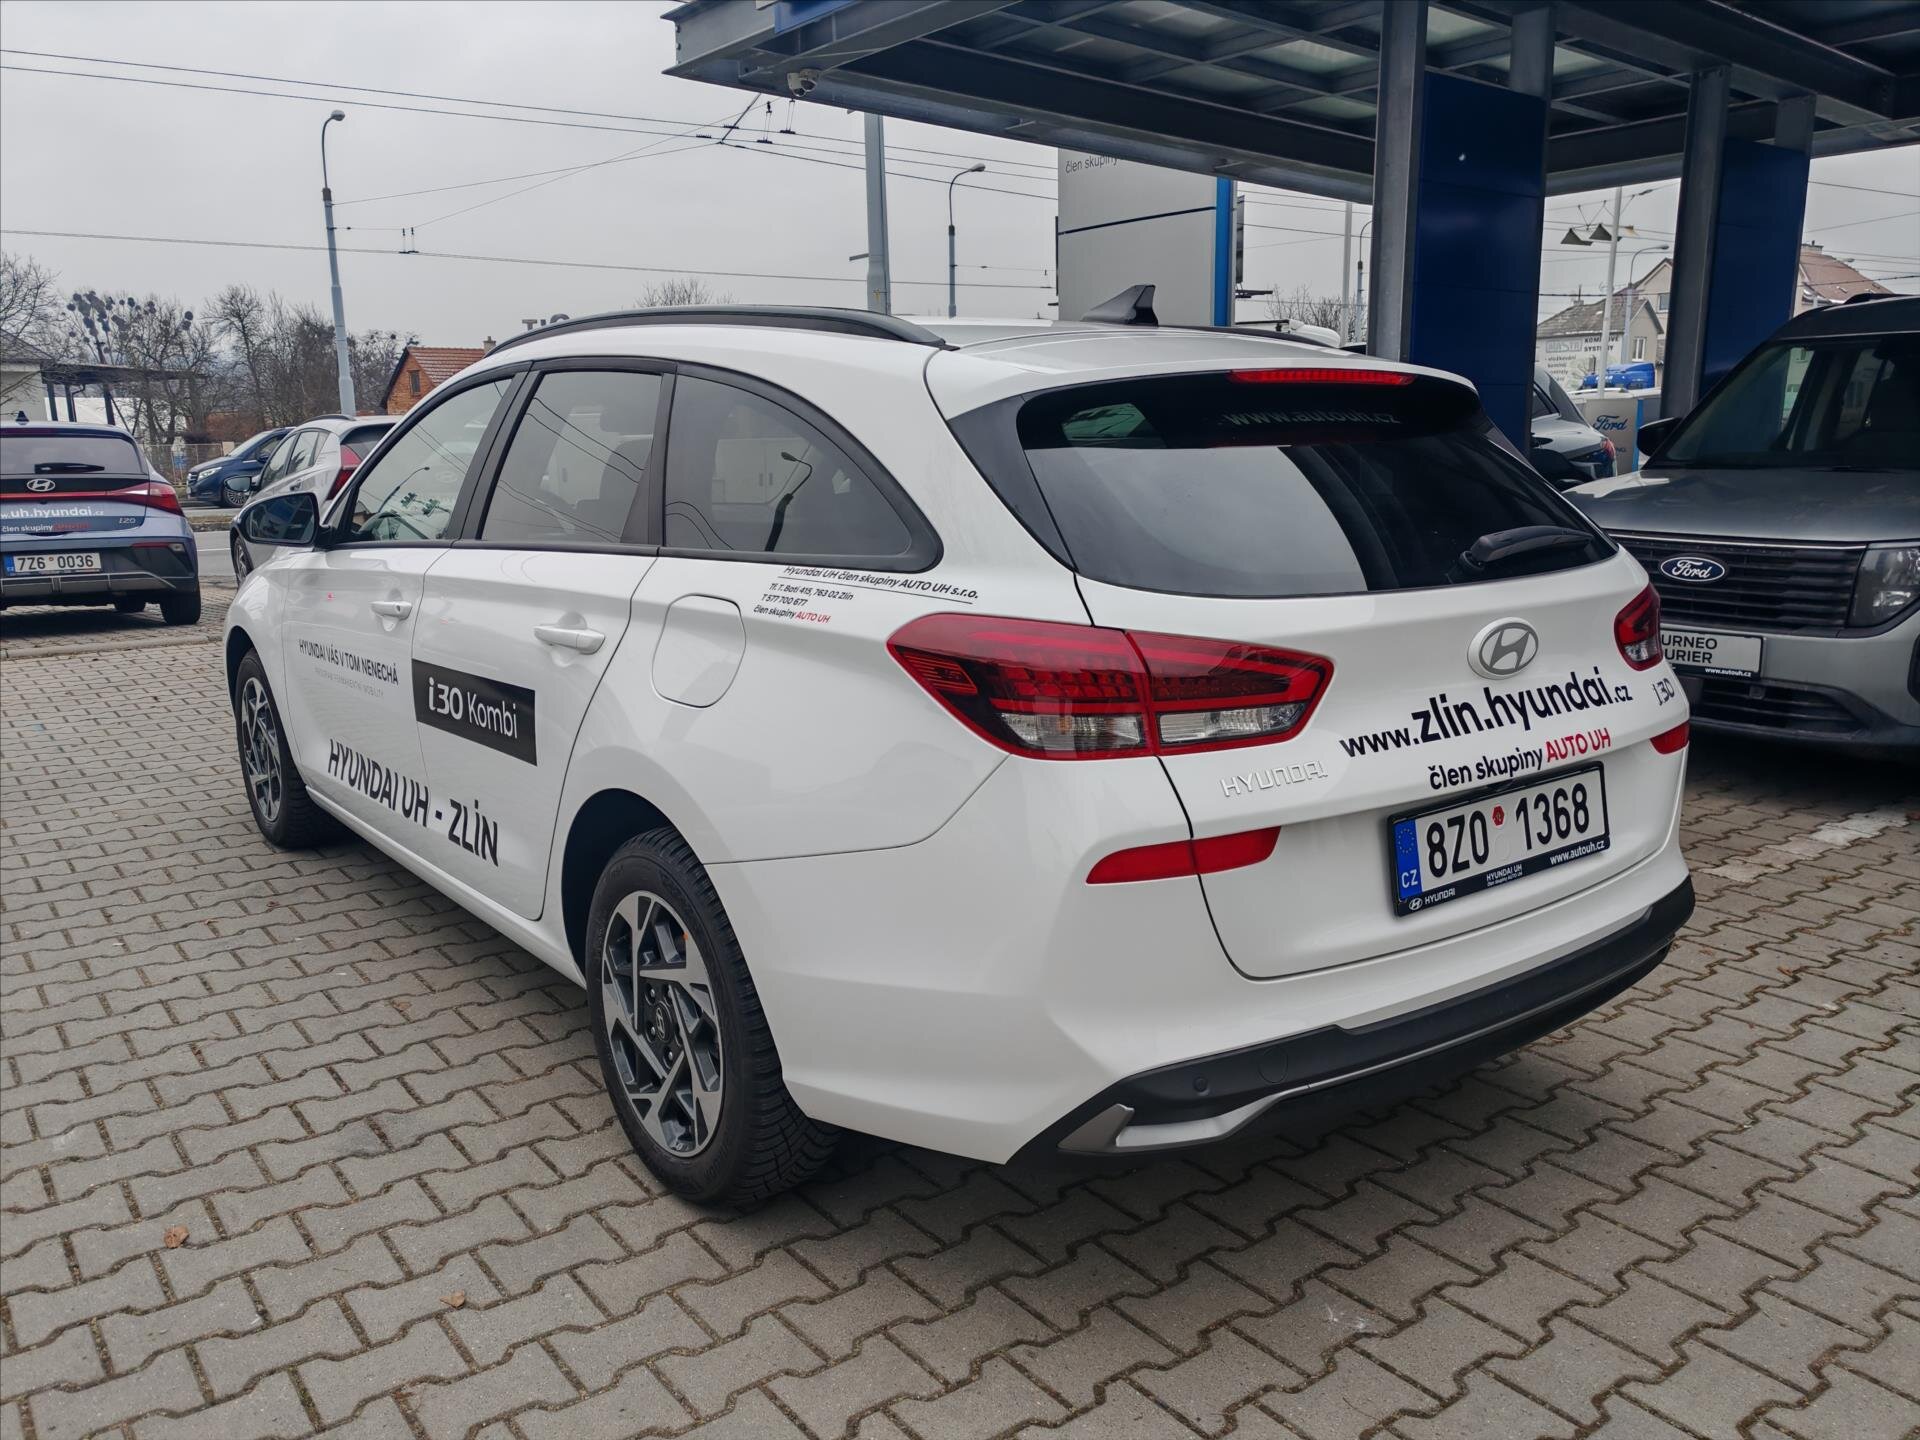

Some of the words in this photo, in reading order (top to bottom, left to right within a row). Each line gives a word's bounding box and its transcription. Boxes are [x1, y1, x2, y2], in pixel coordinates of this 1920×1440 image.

[1065, 160, 1083, 174] člen
[1085, 154, 1118, 169] skupiny
[1593, 414, 1629, 431] Ford
[0, 506, 104, 518] w.uh.hyundai.cz
[2, 524, 20, 532] člen
[21, 523, 53, 532] skupiny
[17, 556, 46, 571] 7Z6
[57, 554, 94, 568] 0036
[1672, 560, 1710, 578] Ford
[784, 566, 823, 575] Hyundai
[823, 569, 838, 578] UH
[838, 571, 859, 581] člen
[859, 574, 900, 586] skupiny
[899, 579, 932, 591] AUTO
[933, 583, 951, 594] UH
[952, 588, 979, 598] s.r.o.
[779, 596, 793, 604] 700
[793, 598, 808, 606] 677
[799, 587, 813, 596] 415,
[828, 591, 839, 599] 02
[839, 592, 854, 600] Zlín
[753, 605, 769, 613] člen
[769, 608, 796, 618] skupiny
[795, 612, 818, 621] AUTO
[817, 615, 831, 623] UH
[1661, 635, 1718, 650] URNEO
[299, 639, 326, 661] HYUNDAI
[325, 644, 339, 665] VÁS
[344, 652, 361, 672] TOM
[361, 656, 399, 686] NENECHÁ
[1665, 649, 1713, 664] URIER
[1705, 667, 1752, 677] www.autouh.cz
[429, 677, 463, 720] i30
[468, 692, 518, 739] Kombi
[1339, 666, 1633, 758] www.zlin.hyundai.cz
[1428, 764, 1473, 790] člen
[1475, 747, 1543, 780] skupiny
[1545, 733, 1589, 763] AUTO
[1588, 728, 1612, 751] UH
[1220, 760, 1328, 798] HYUNDAI
[328, 738, 398, 812] HYUNDAI
[403, 775, 429, 828] UH
[448, 799, 499, 868] ZLÍN
[1426, 810, 1490, 878] 8Z0
[1514, 782, 1590, 851] 1368
[1550, 839, 1606, 866] www.autouh.cz
[1401, 869, 1419, 889] CZ
[1486, 866, 1514, 882] HYUNDAI
[1513, 864, 1523, 872] UH
[1424, 887, 1456, 905] HYUNDAI
